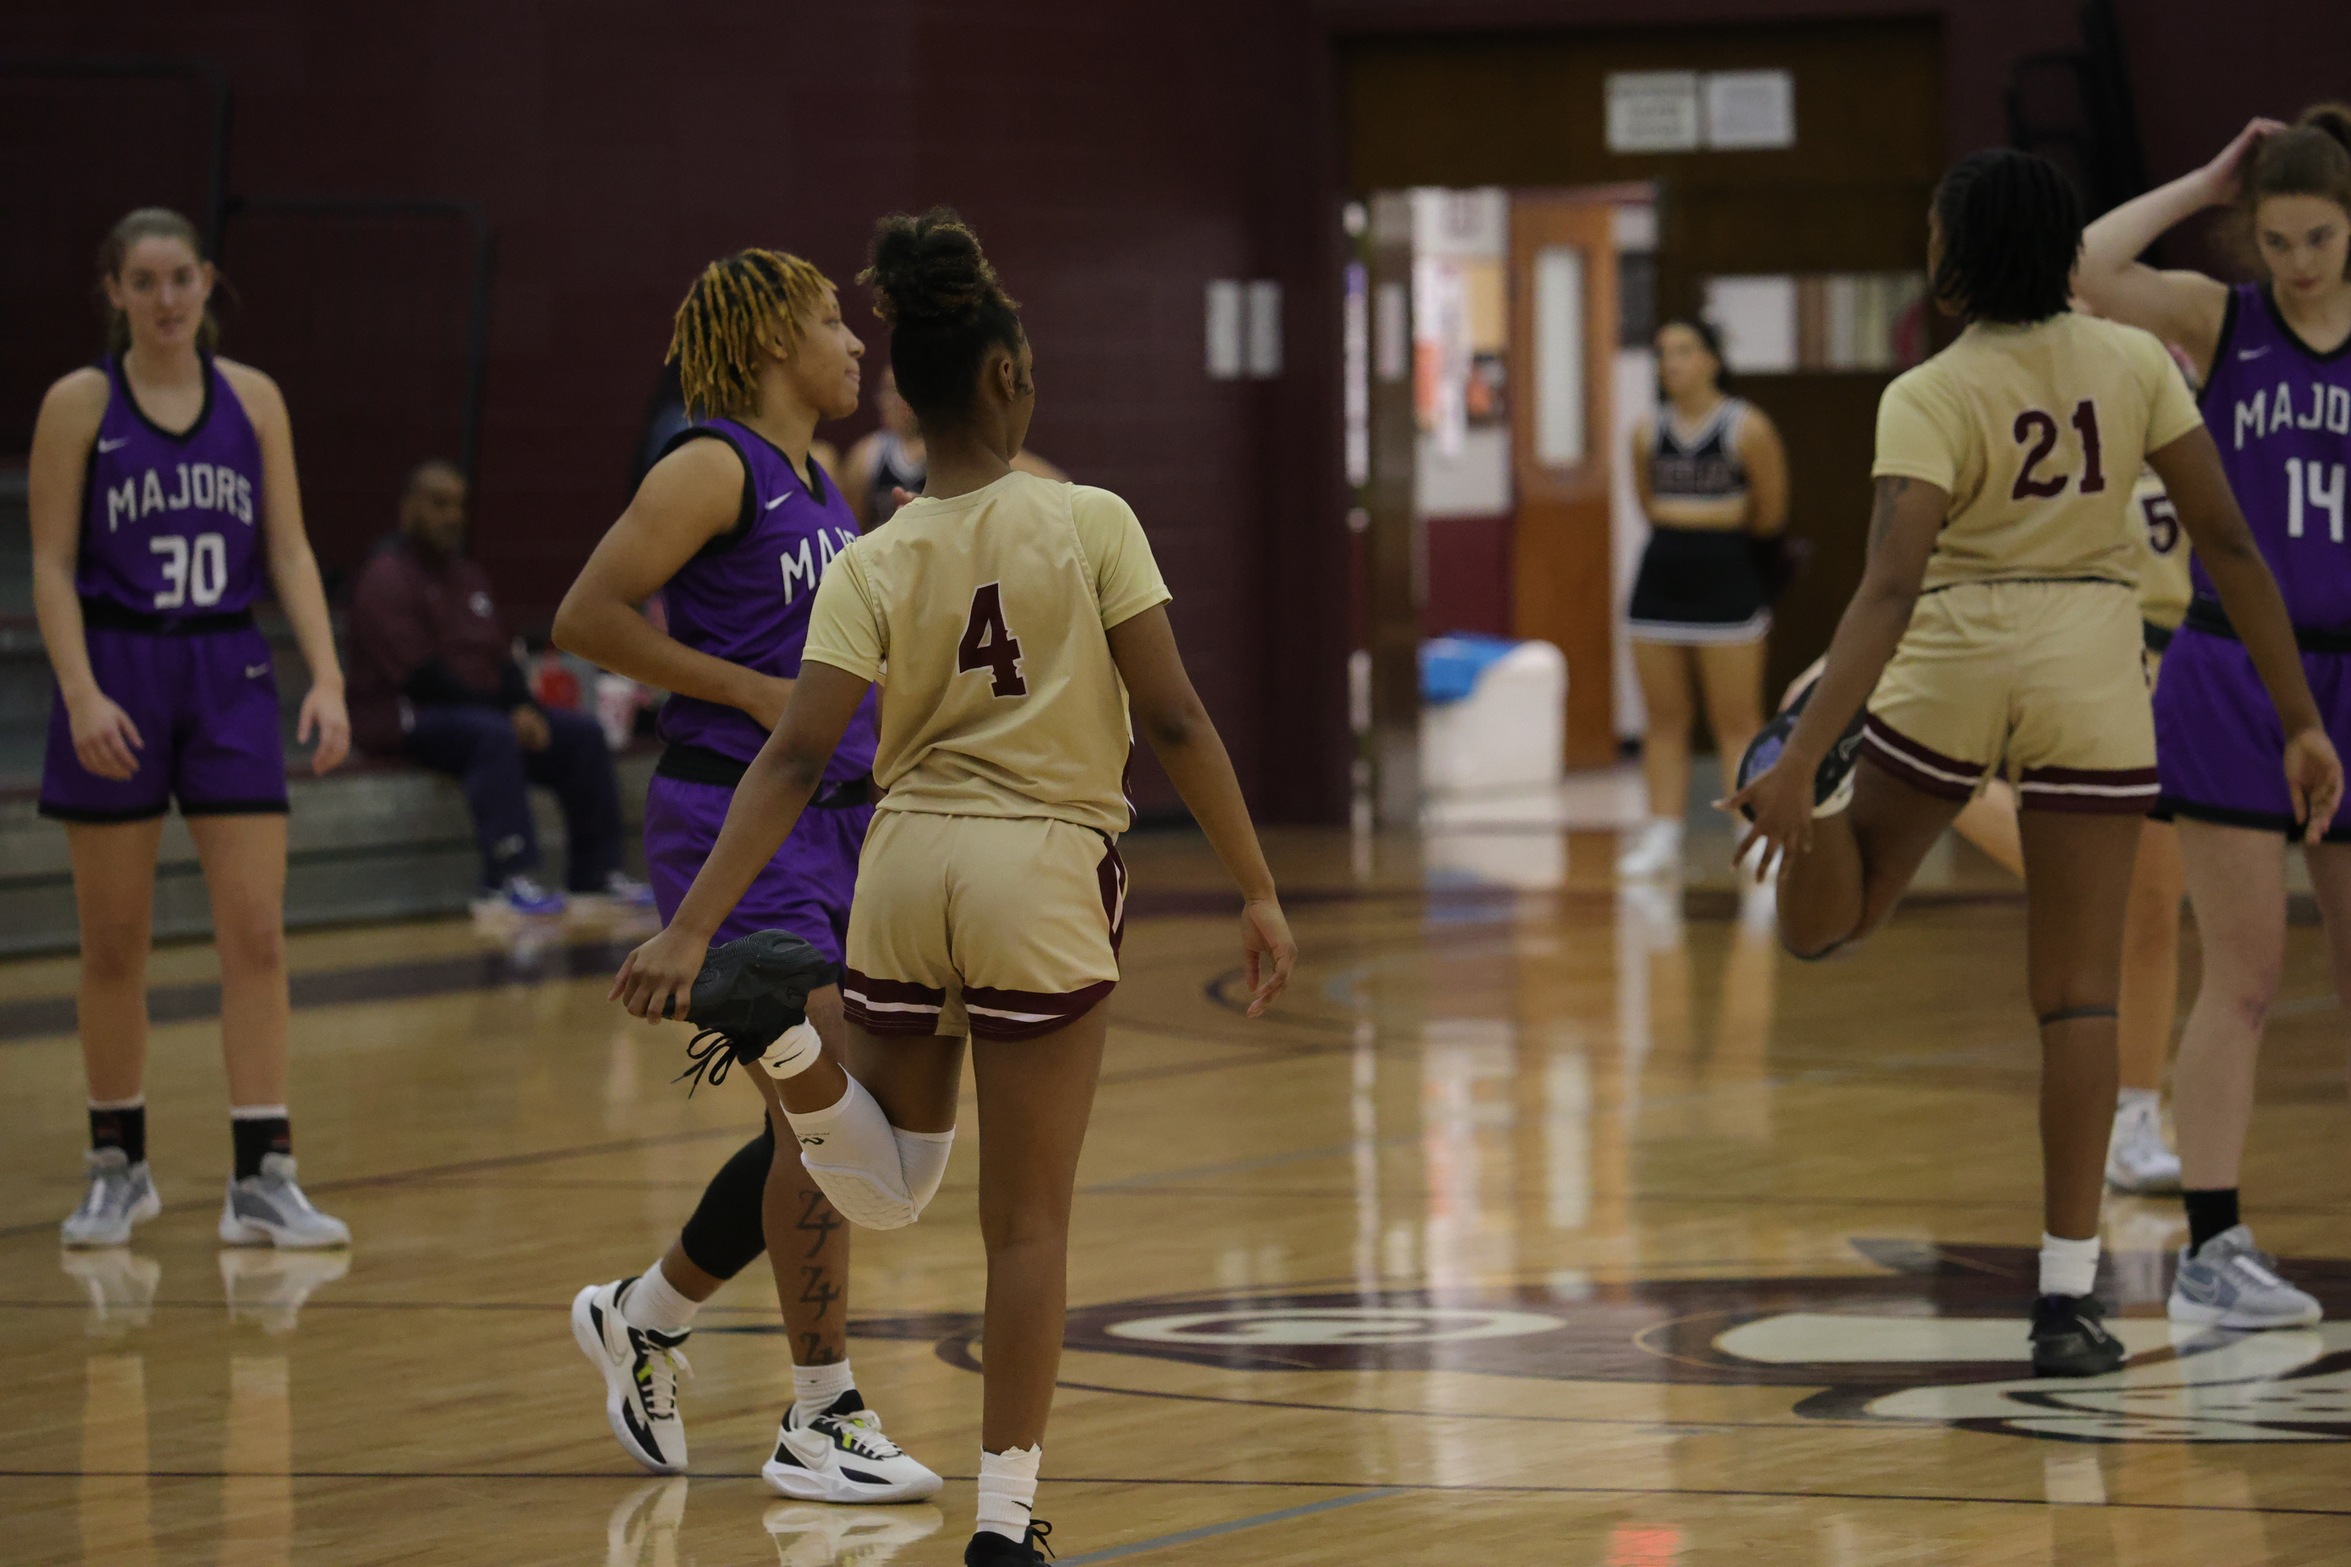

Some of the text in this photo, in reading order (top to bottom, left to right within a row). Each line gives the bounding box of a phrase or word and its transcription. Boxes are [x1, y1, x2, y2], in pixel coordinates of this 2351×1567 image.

[2012, 400, 2105, 500] 21
[107, 462, 254, 534] MAJORS
[2140, 496, 2179, 554] 5
[2284, 456, 2346, 544] 14
[149, 531, 229, 610] 30
[957, 580, 1029, 699] 4
